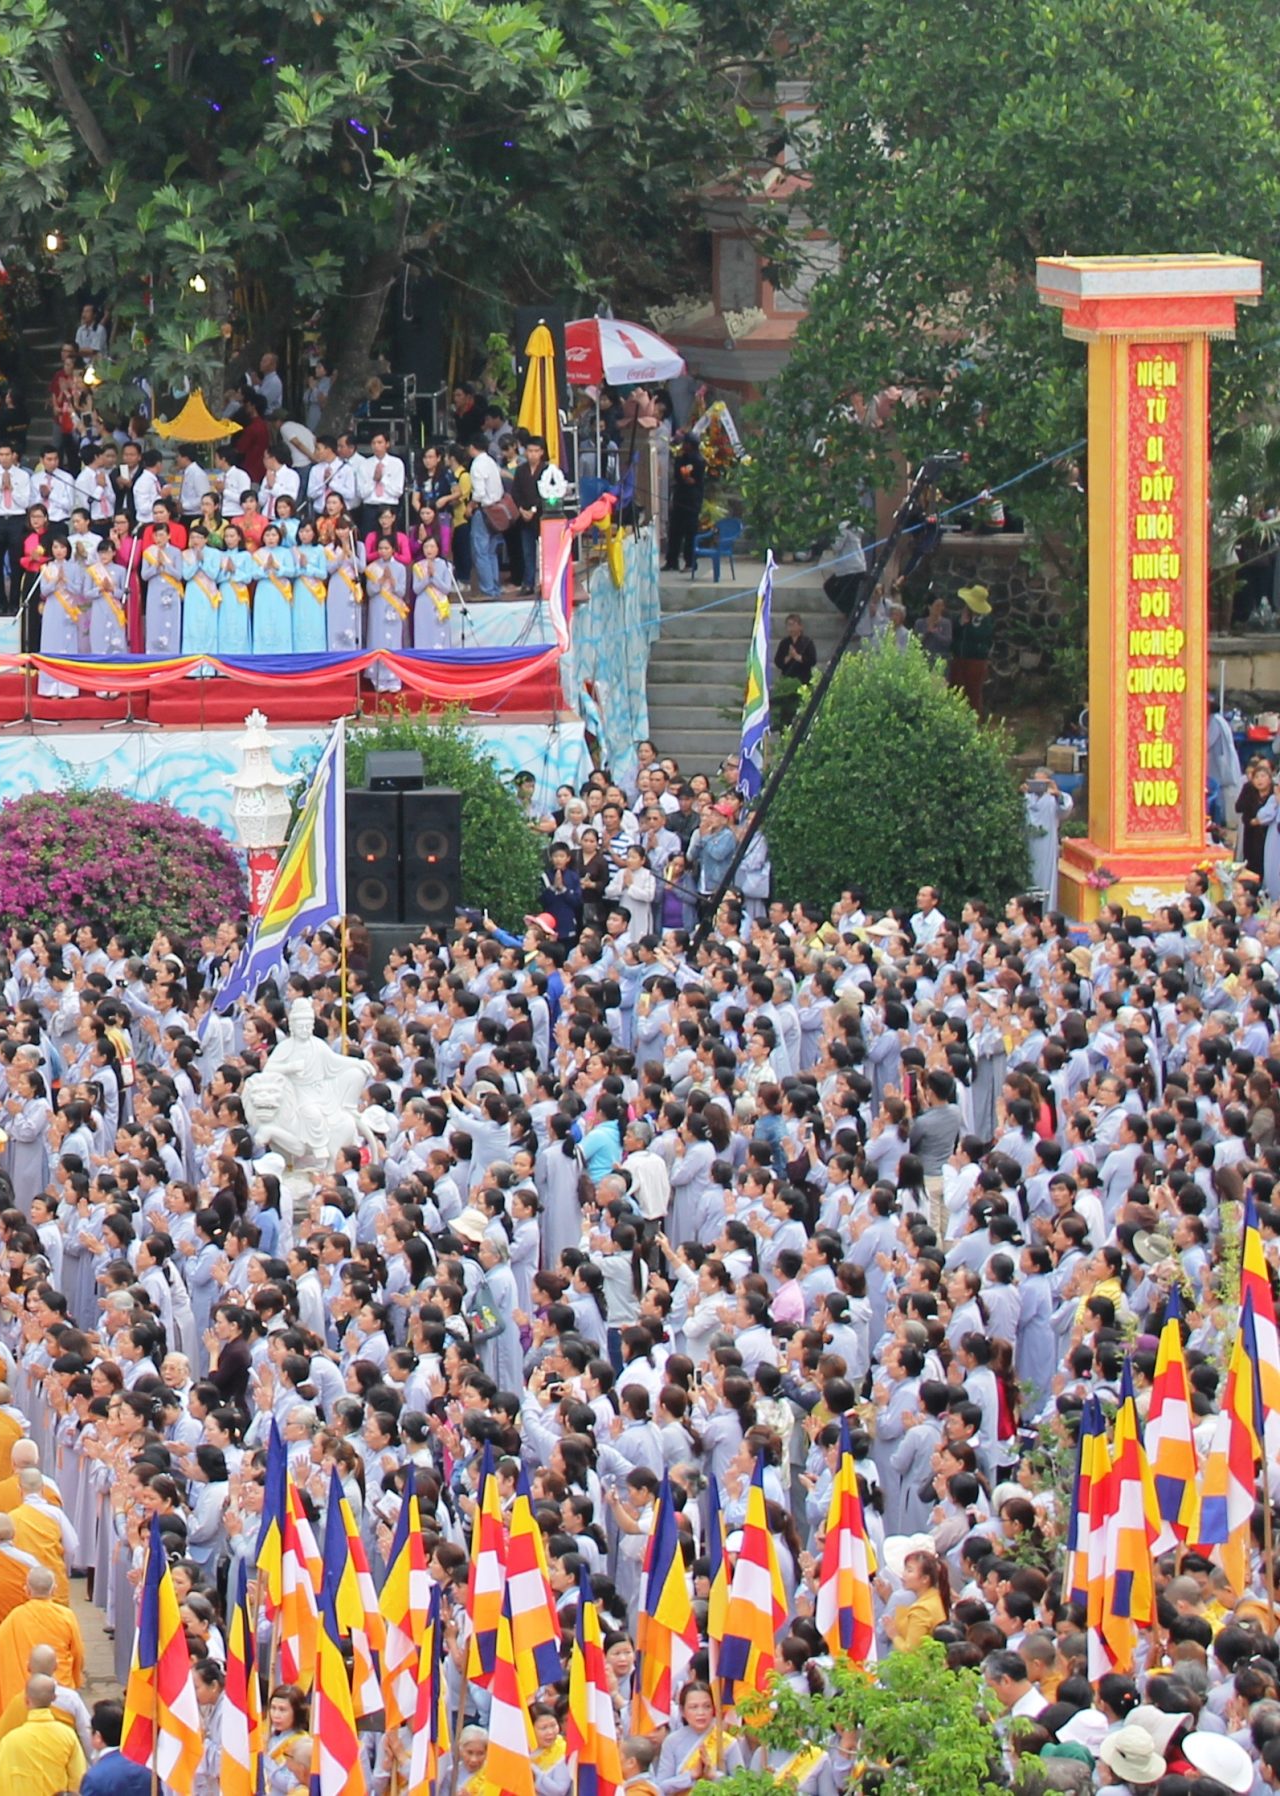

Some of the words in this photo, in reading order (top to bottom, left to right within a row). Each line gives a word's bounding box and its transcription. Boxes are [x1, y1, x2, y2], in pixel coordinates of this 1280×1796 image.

[1136, 355, 1177, 391] NIỆM
[1147, 393, 1167, 424] TỪ
[1147, 436, 1164, 462] BI
[1141, 466, 1174, 501] DẤY
[1140, 587, 1170, 618] ĐỜI
[1129, 625, 1184, 659] NGHIỆP
[1127, 661, 1186, 693] CHƯỚNG
[1145, 705, 1166, 736] TỰ
[1138, 738, 1173, 769] TIÊU
[1133, 780, 1178, 807] VONG
